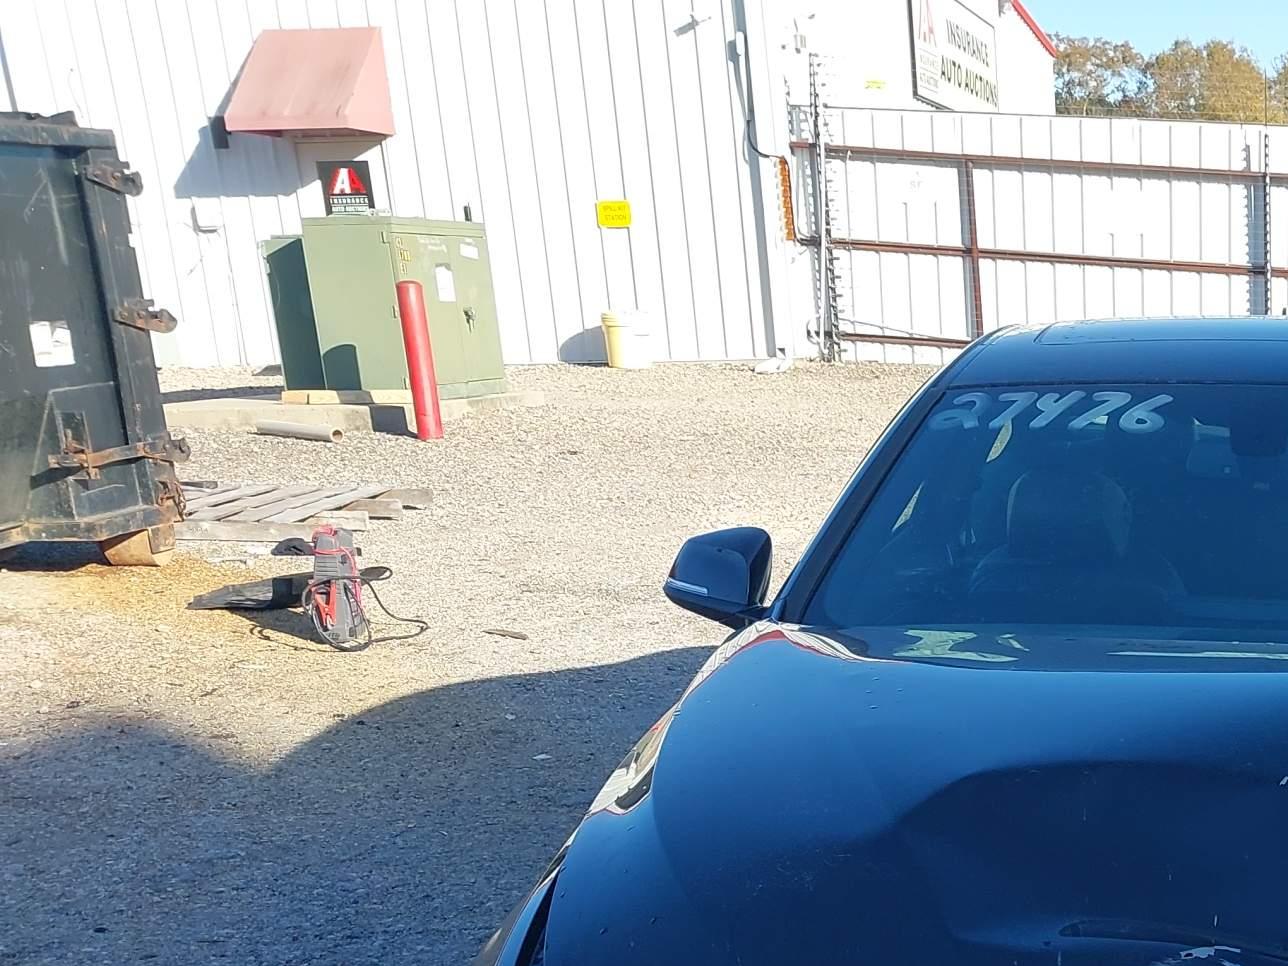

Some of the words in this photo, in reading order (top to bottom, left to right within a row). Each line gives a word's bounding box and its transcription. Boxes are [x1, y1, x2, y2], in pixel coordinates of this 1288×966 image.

[945, 18, 989, 67] INSURANCE
[941, 55, 963, 88] AUTO
[964, 66, 998, 108] AUCTIONS
